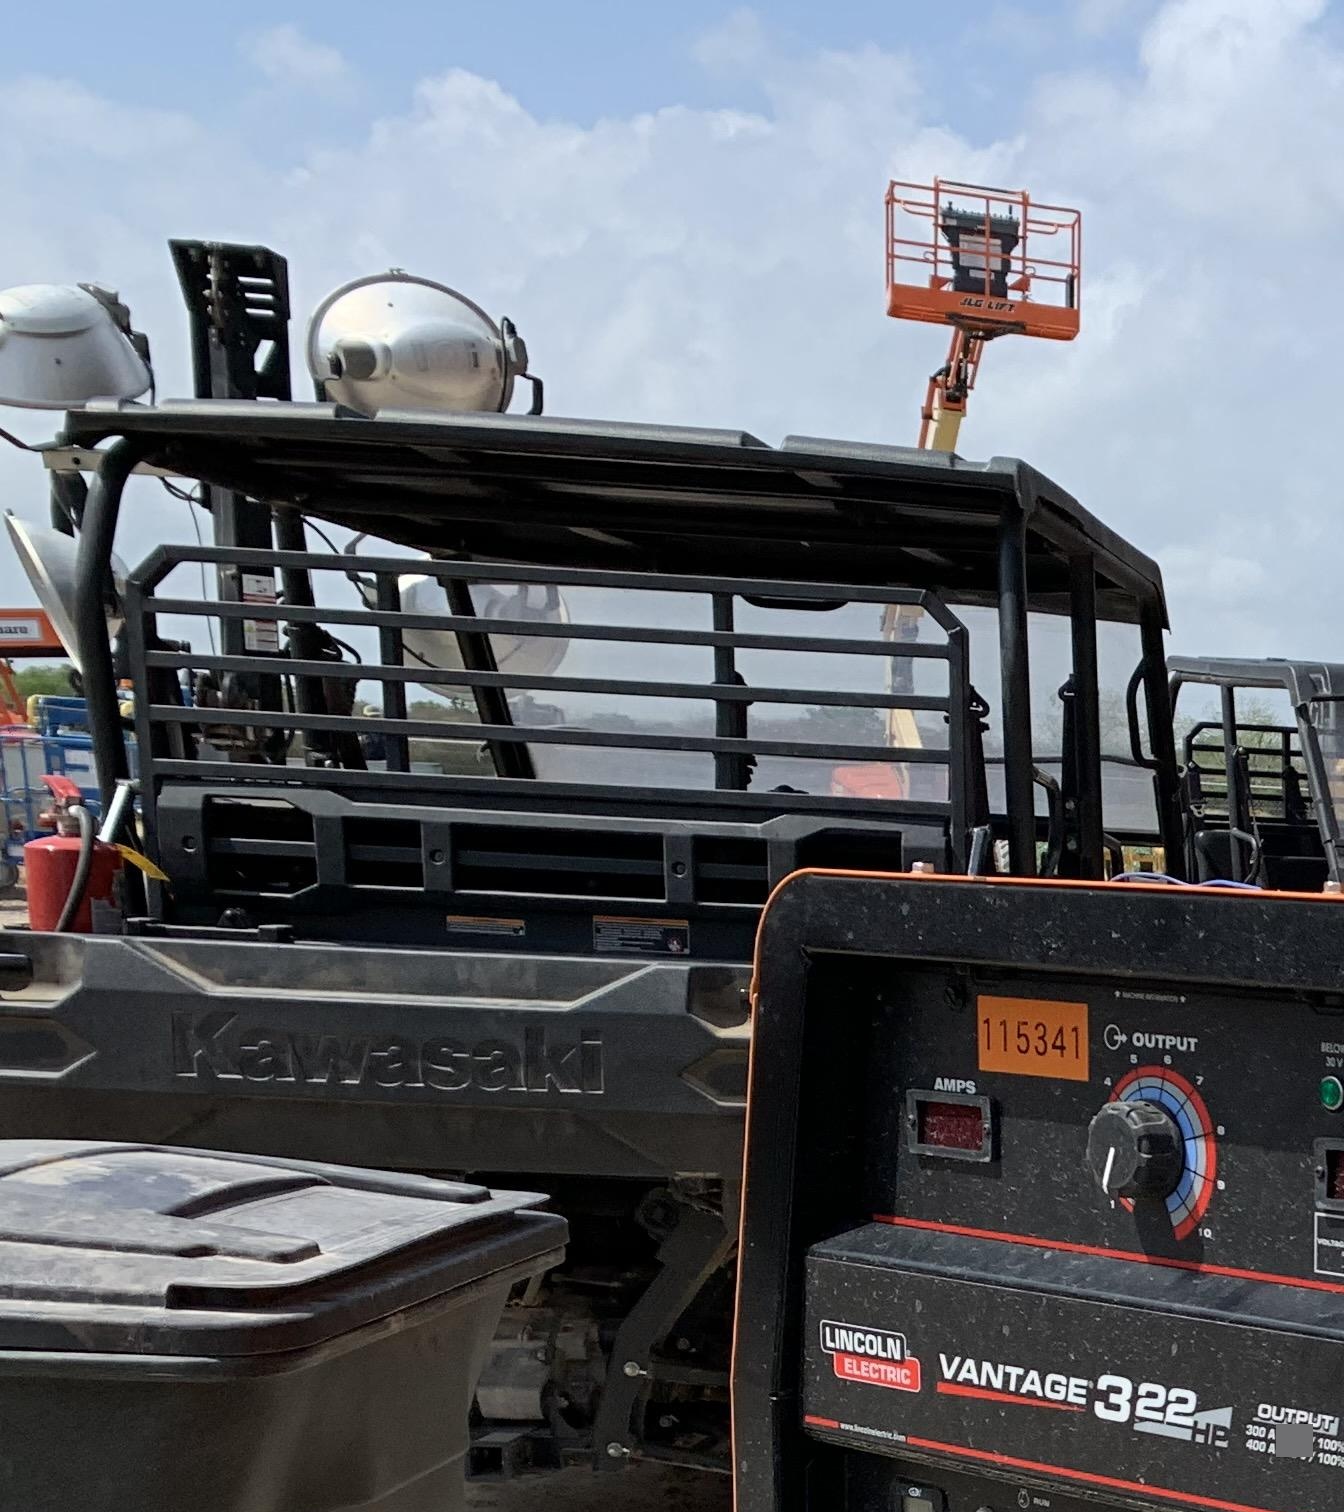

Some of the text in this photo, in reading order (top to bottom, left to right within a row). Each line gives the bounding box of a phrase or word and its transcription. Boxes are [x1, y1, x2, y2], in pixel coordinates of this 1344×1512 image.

[982, 1017, 1081, 1060] 115341
[1131, 1032, 1199, 1052] OUTPUT
[171, 1010, 605, 1095] Kawasaki
[1130, 1054, 1138, 1064] 5
[1163, 1054, 1172, 1065] 6
[933, 1077, 977, 1095] AMPS
[1103, 1076, 1112, 1086] 4
[1196, 1075, 1204, 1086] 7
[1216, 1125, 1226, 1136] 8
[1216, 1180, 1226, 1191] 9
[824, 1325, 901, 1361] LINCOLN
[843, 1357, 911, 1386] ELECTRIC
[938, 1353, 1089, 1405] VANTAGE
[1093, 1374, 1199, 1428] 322
[1256, 1403, 1335, 1431] OUTPUT
[1245, 1424, 1265, 1437] 300
[1267, 1428, 1276, 1440] A
[1245, 1438, 1266, 1452] 400
[1033, 1496, 1051, 1508] RUN
